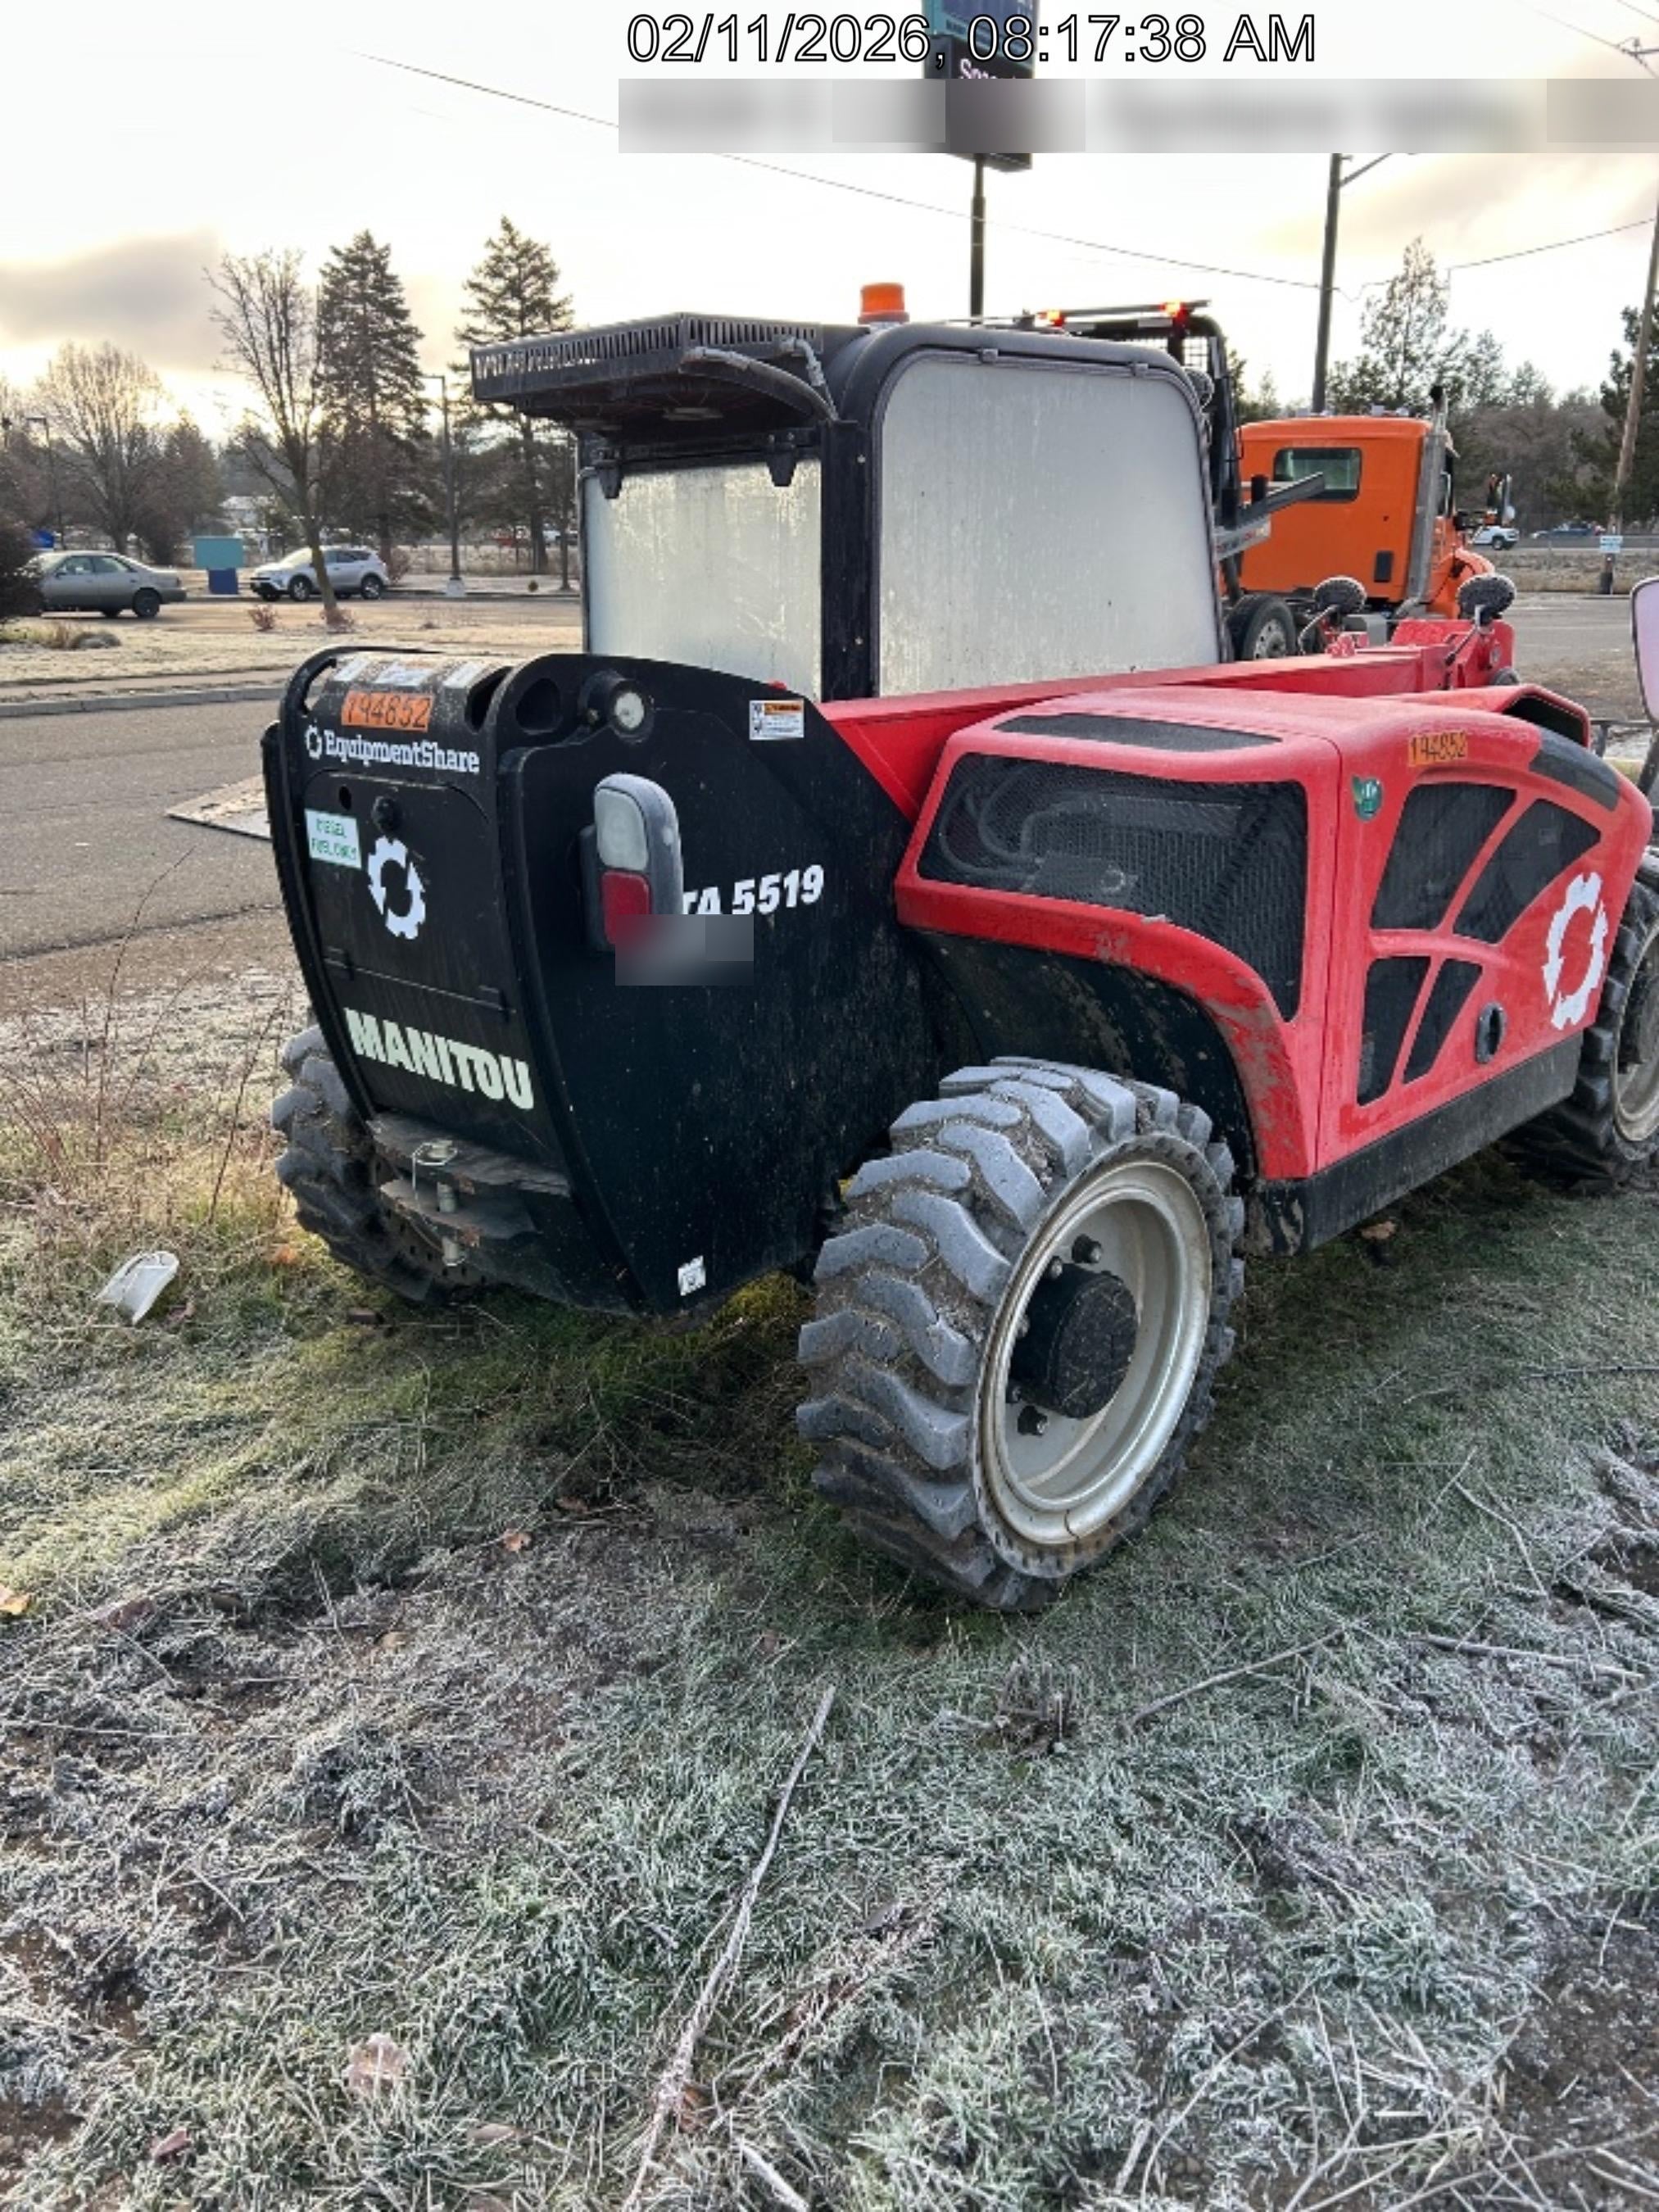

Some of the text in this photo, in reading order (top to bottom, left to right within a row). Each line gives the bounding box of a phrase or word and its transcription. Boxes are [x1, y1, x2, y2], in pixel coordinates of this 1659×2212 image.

[324, 730, 480, 773] EquipmentShare
[732, 864, 824, 915] 5519
[343, 1007, 534, 1109] MANITOU
